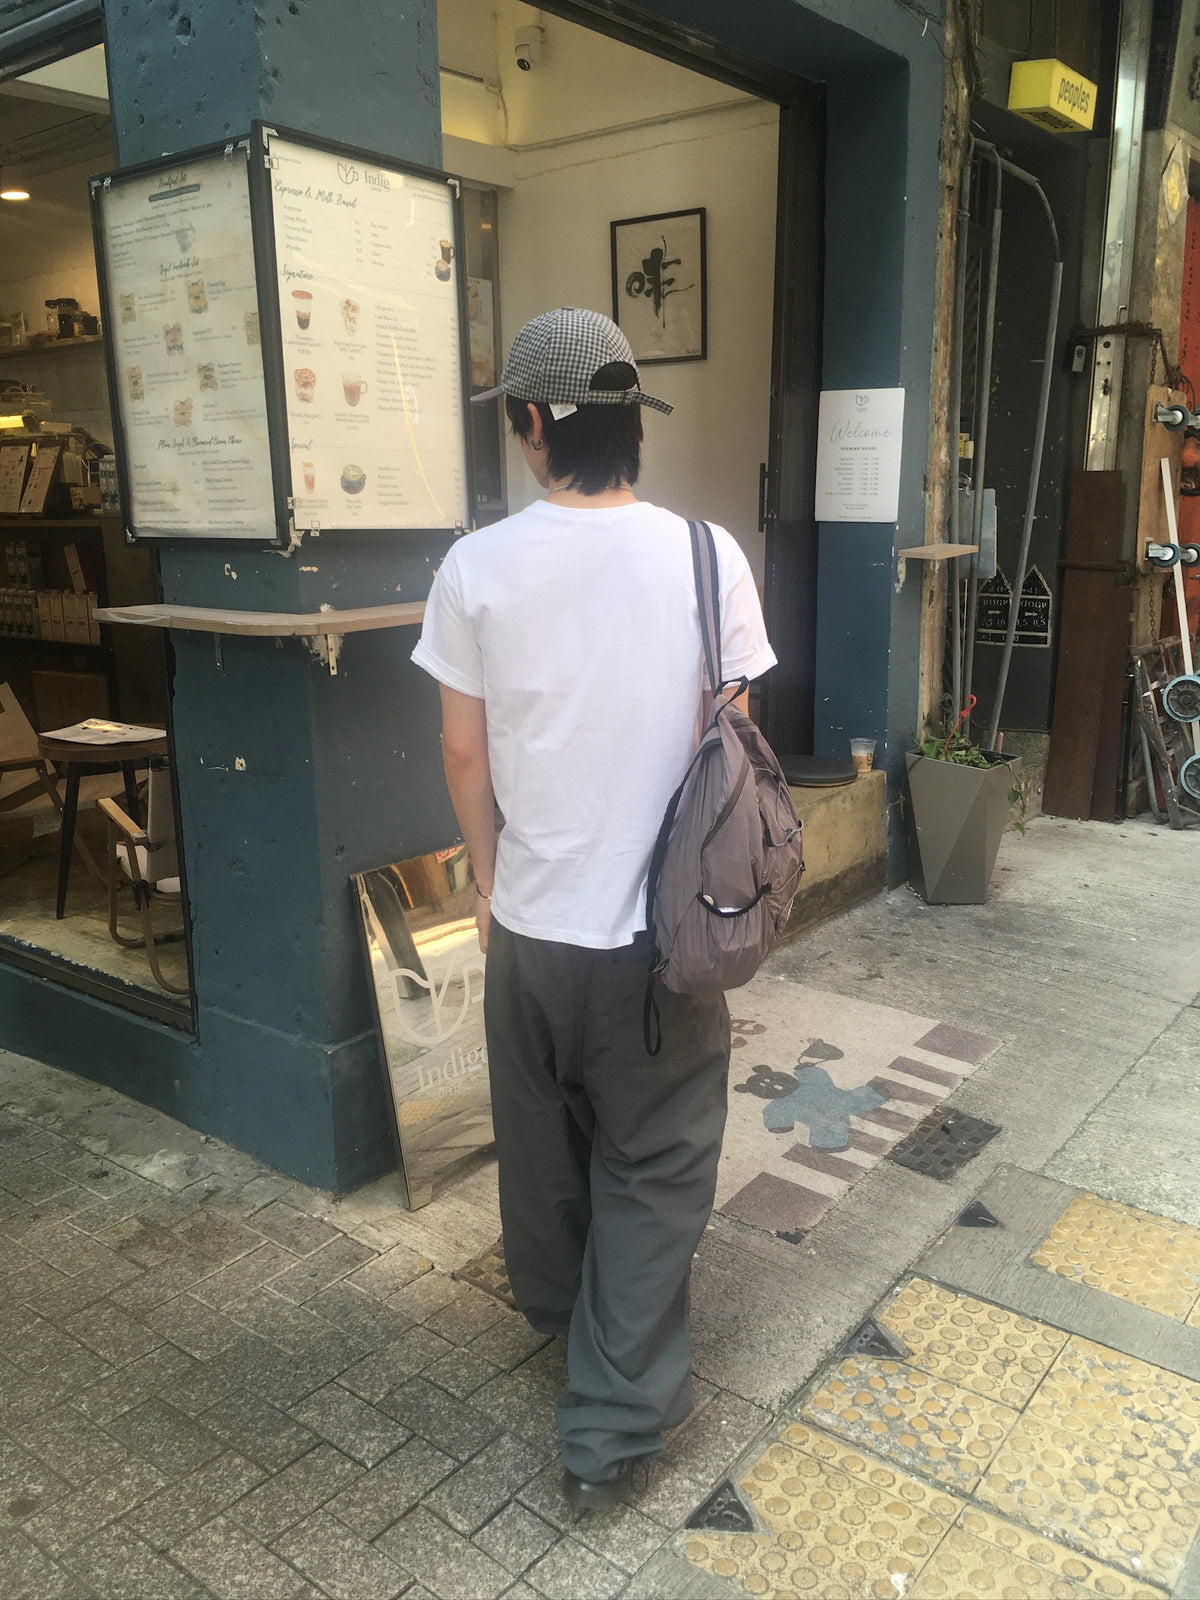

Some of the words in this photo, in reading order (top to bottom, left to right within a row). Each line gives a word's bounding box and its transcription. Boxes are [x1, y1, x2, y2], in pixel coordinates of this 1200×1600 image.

[1057, 77, 1091, 114] peoples
[280, 263, 314, 282] Signature
[830, 419, 892, 443] Welcome
